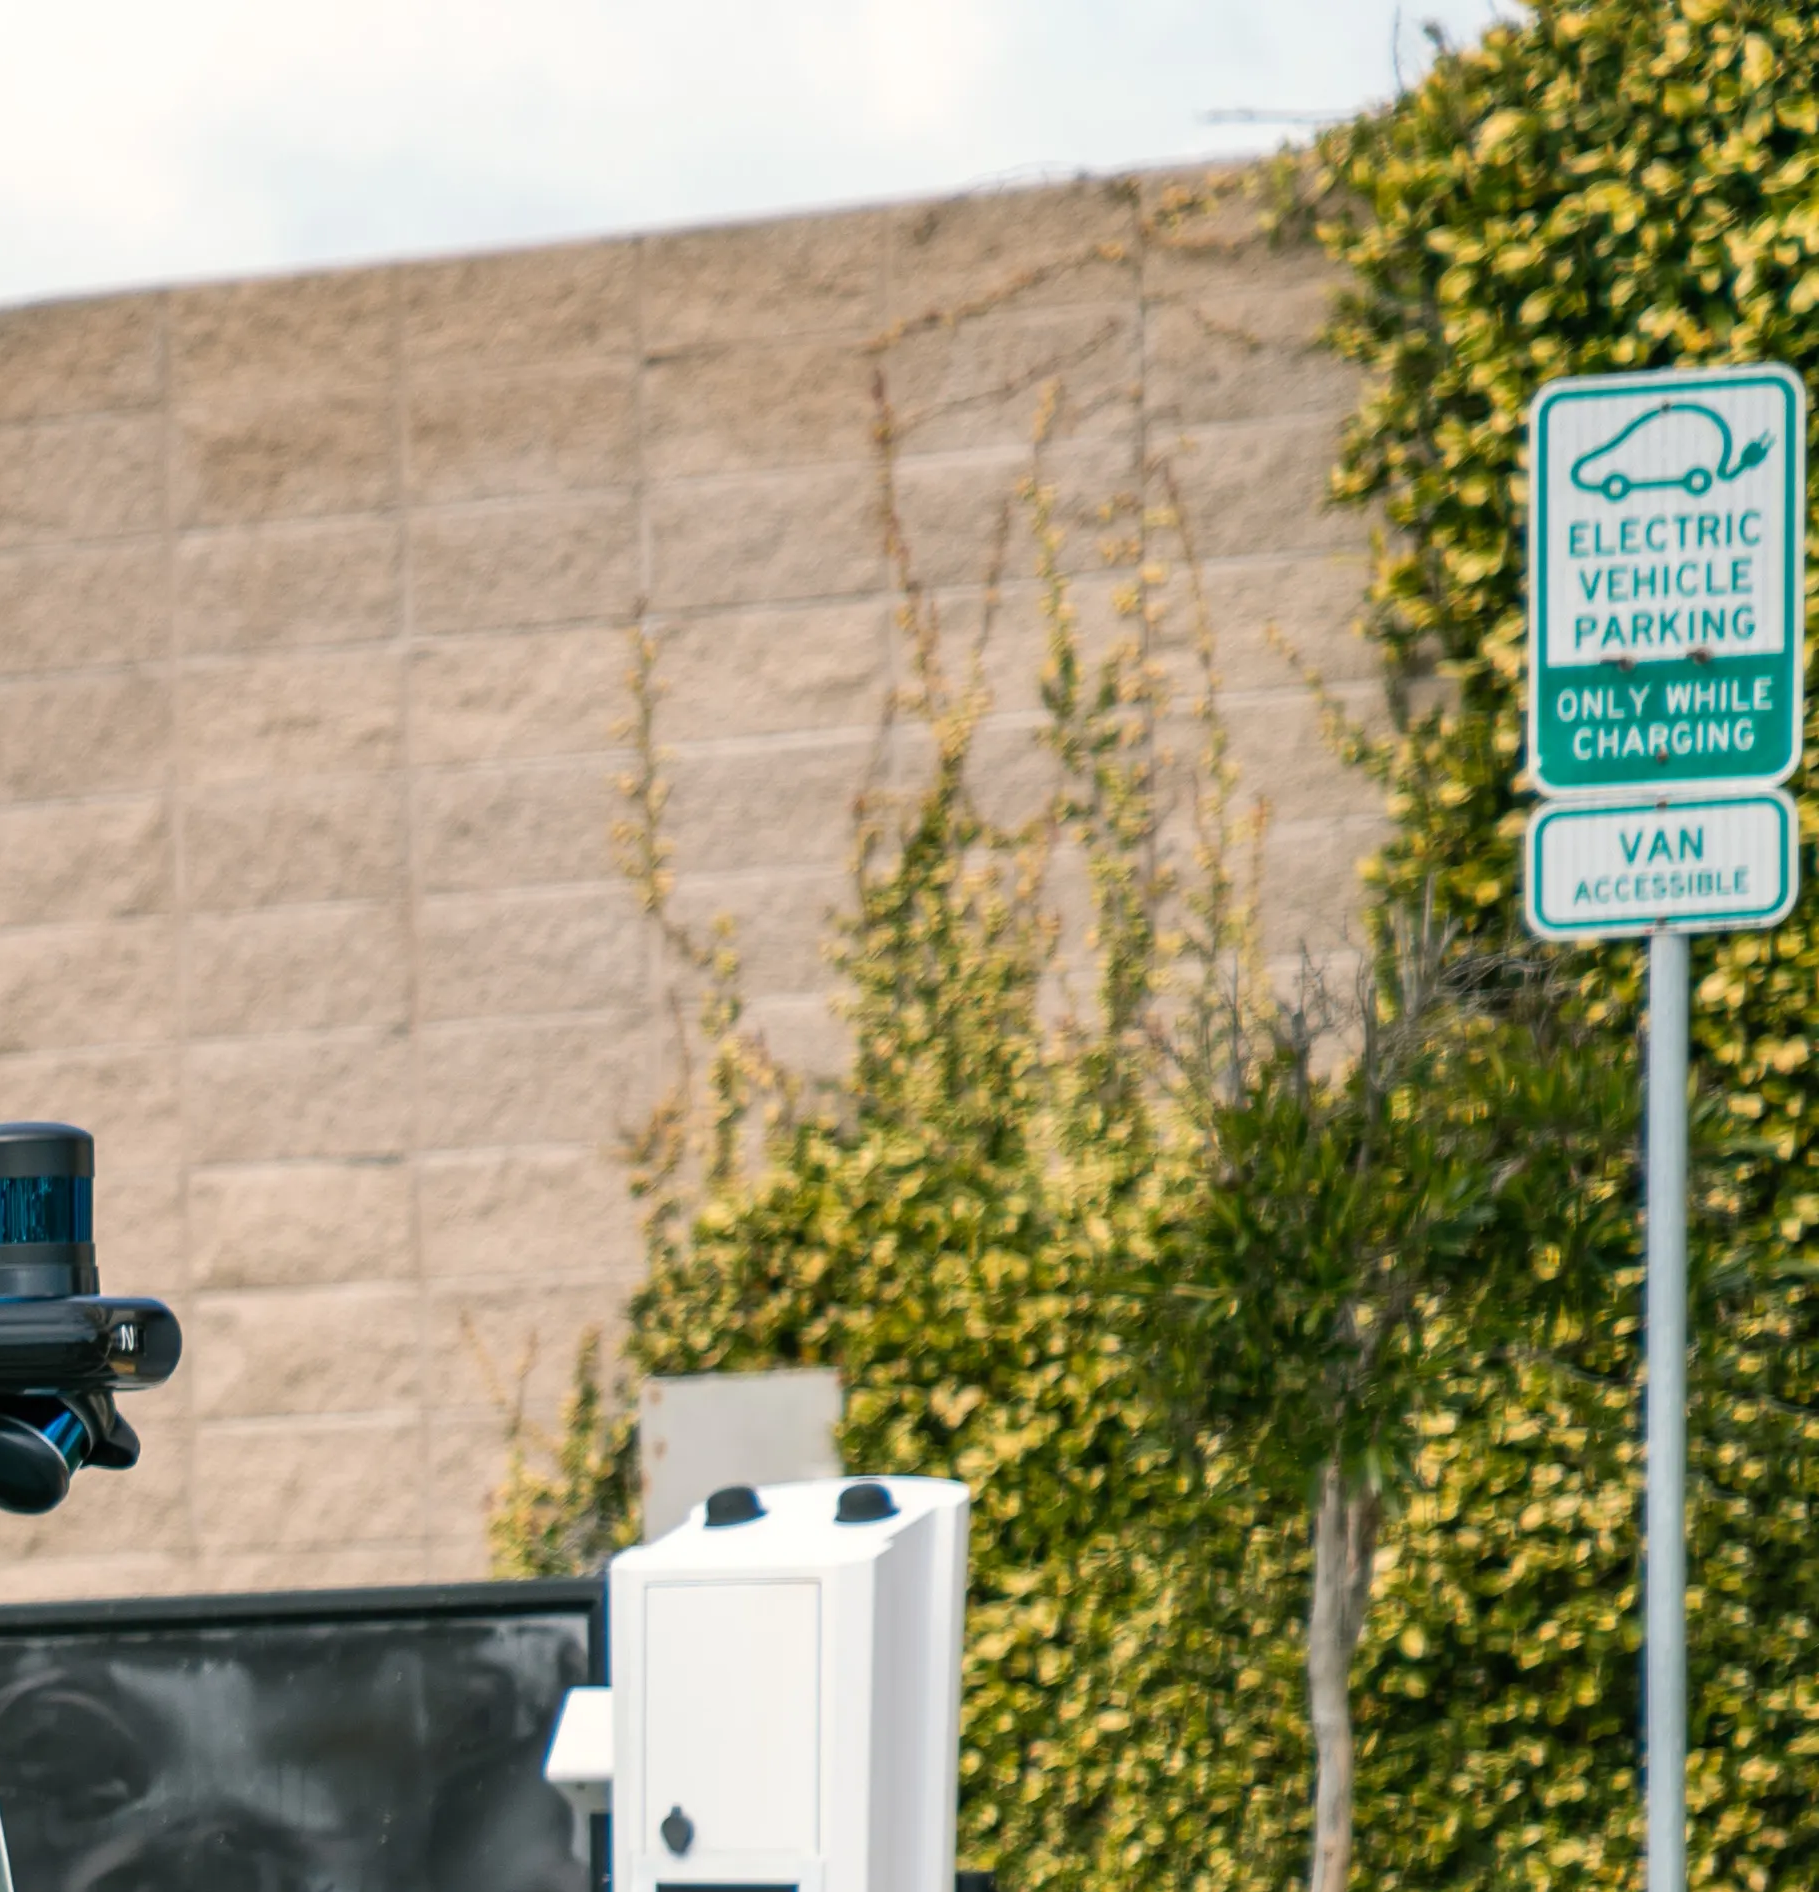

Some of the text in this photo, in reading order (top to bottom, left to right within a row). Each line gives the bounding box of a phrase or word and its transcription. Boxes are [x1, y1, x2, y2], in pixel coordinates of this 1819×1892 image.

[1568, 510, 1763, 558] ELECTRIC
[1579, 557, 1753, 604] VEHICLE
[1574, 606, 1757, 651] PARKING
[1556, 676, 1774, 724] ONLY WHILE
[1573, 720, 1755, 761] CHARGING
[1618, 826, 1705, 865] VAN
[1574, 866, 1750, 906] ACCESSIBLE
